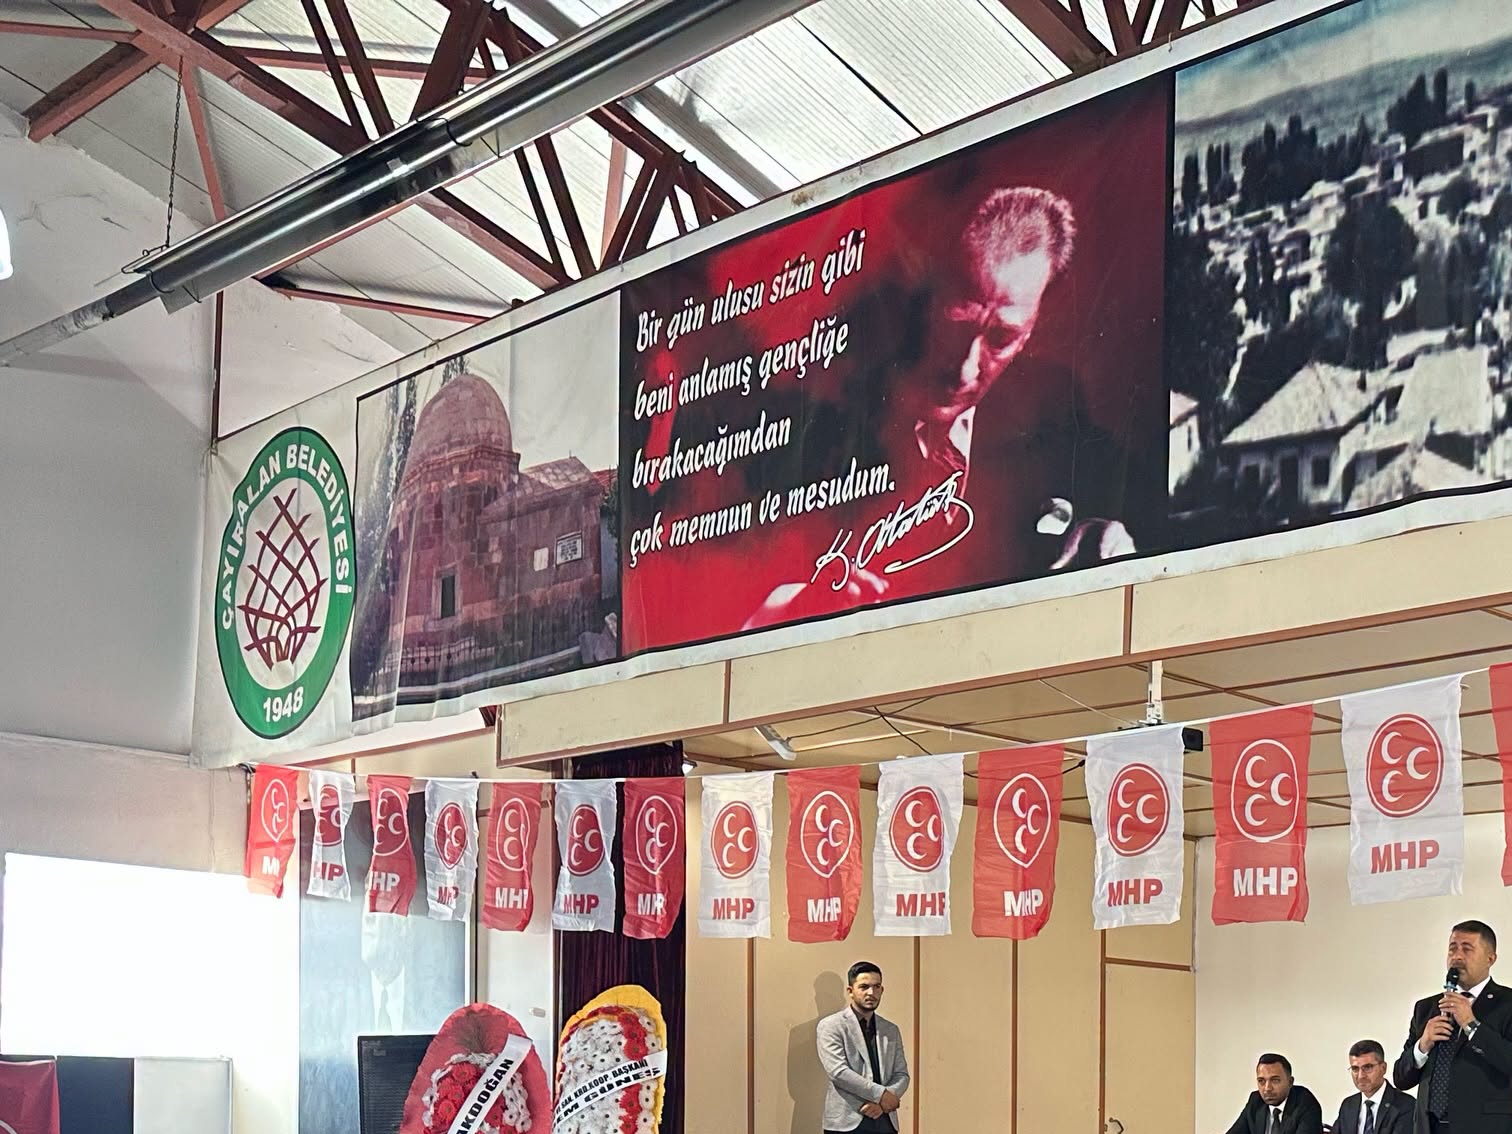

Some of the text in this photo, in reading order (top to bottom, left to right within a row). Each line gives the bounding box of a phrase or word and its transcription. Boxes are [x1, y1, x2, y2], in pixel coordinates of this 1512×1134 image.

[636, 228, 866, 352] Bir gün ulusu sizin gibi
[634, 316, 849, 420] beni anlamış gençliğe
[632, 410, 791, 488] bırakacağımdan
[629, 457, 896, 568] çok memnun ve mesudum.
[221, 444, 352, 630] ÇAYIRALAN BELEDİYESİ
[263, 687, 304, 722] 1948
[313, 862, 344, 881] HP
[1371, 839, 1439, 874] MHP
[373, 871, 400, 891] HP
[1107, 878, 1163, 907] MHP
[1233, 867, 1298, 897] MHP
[563, 894, 600, 914] MHP
[712, 898, 755, 920] MHP
[807, 897, 842, 923] MHP
[1004, 888, 1042, 917] MHP
